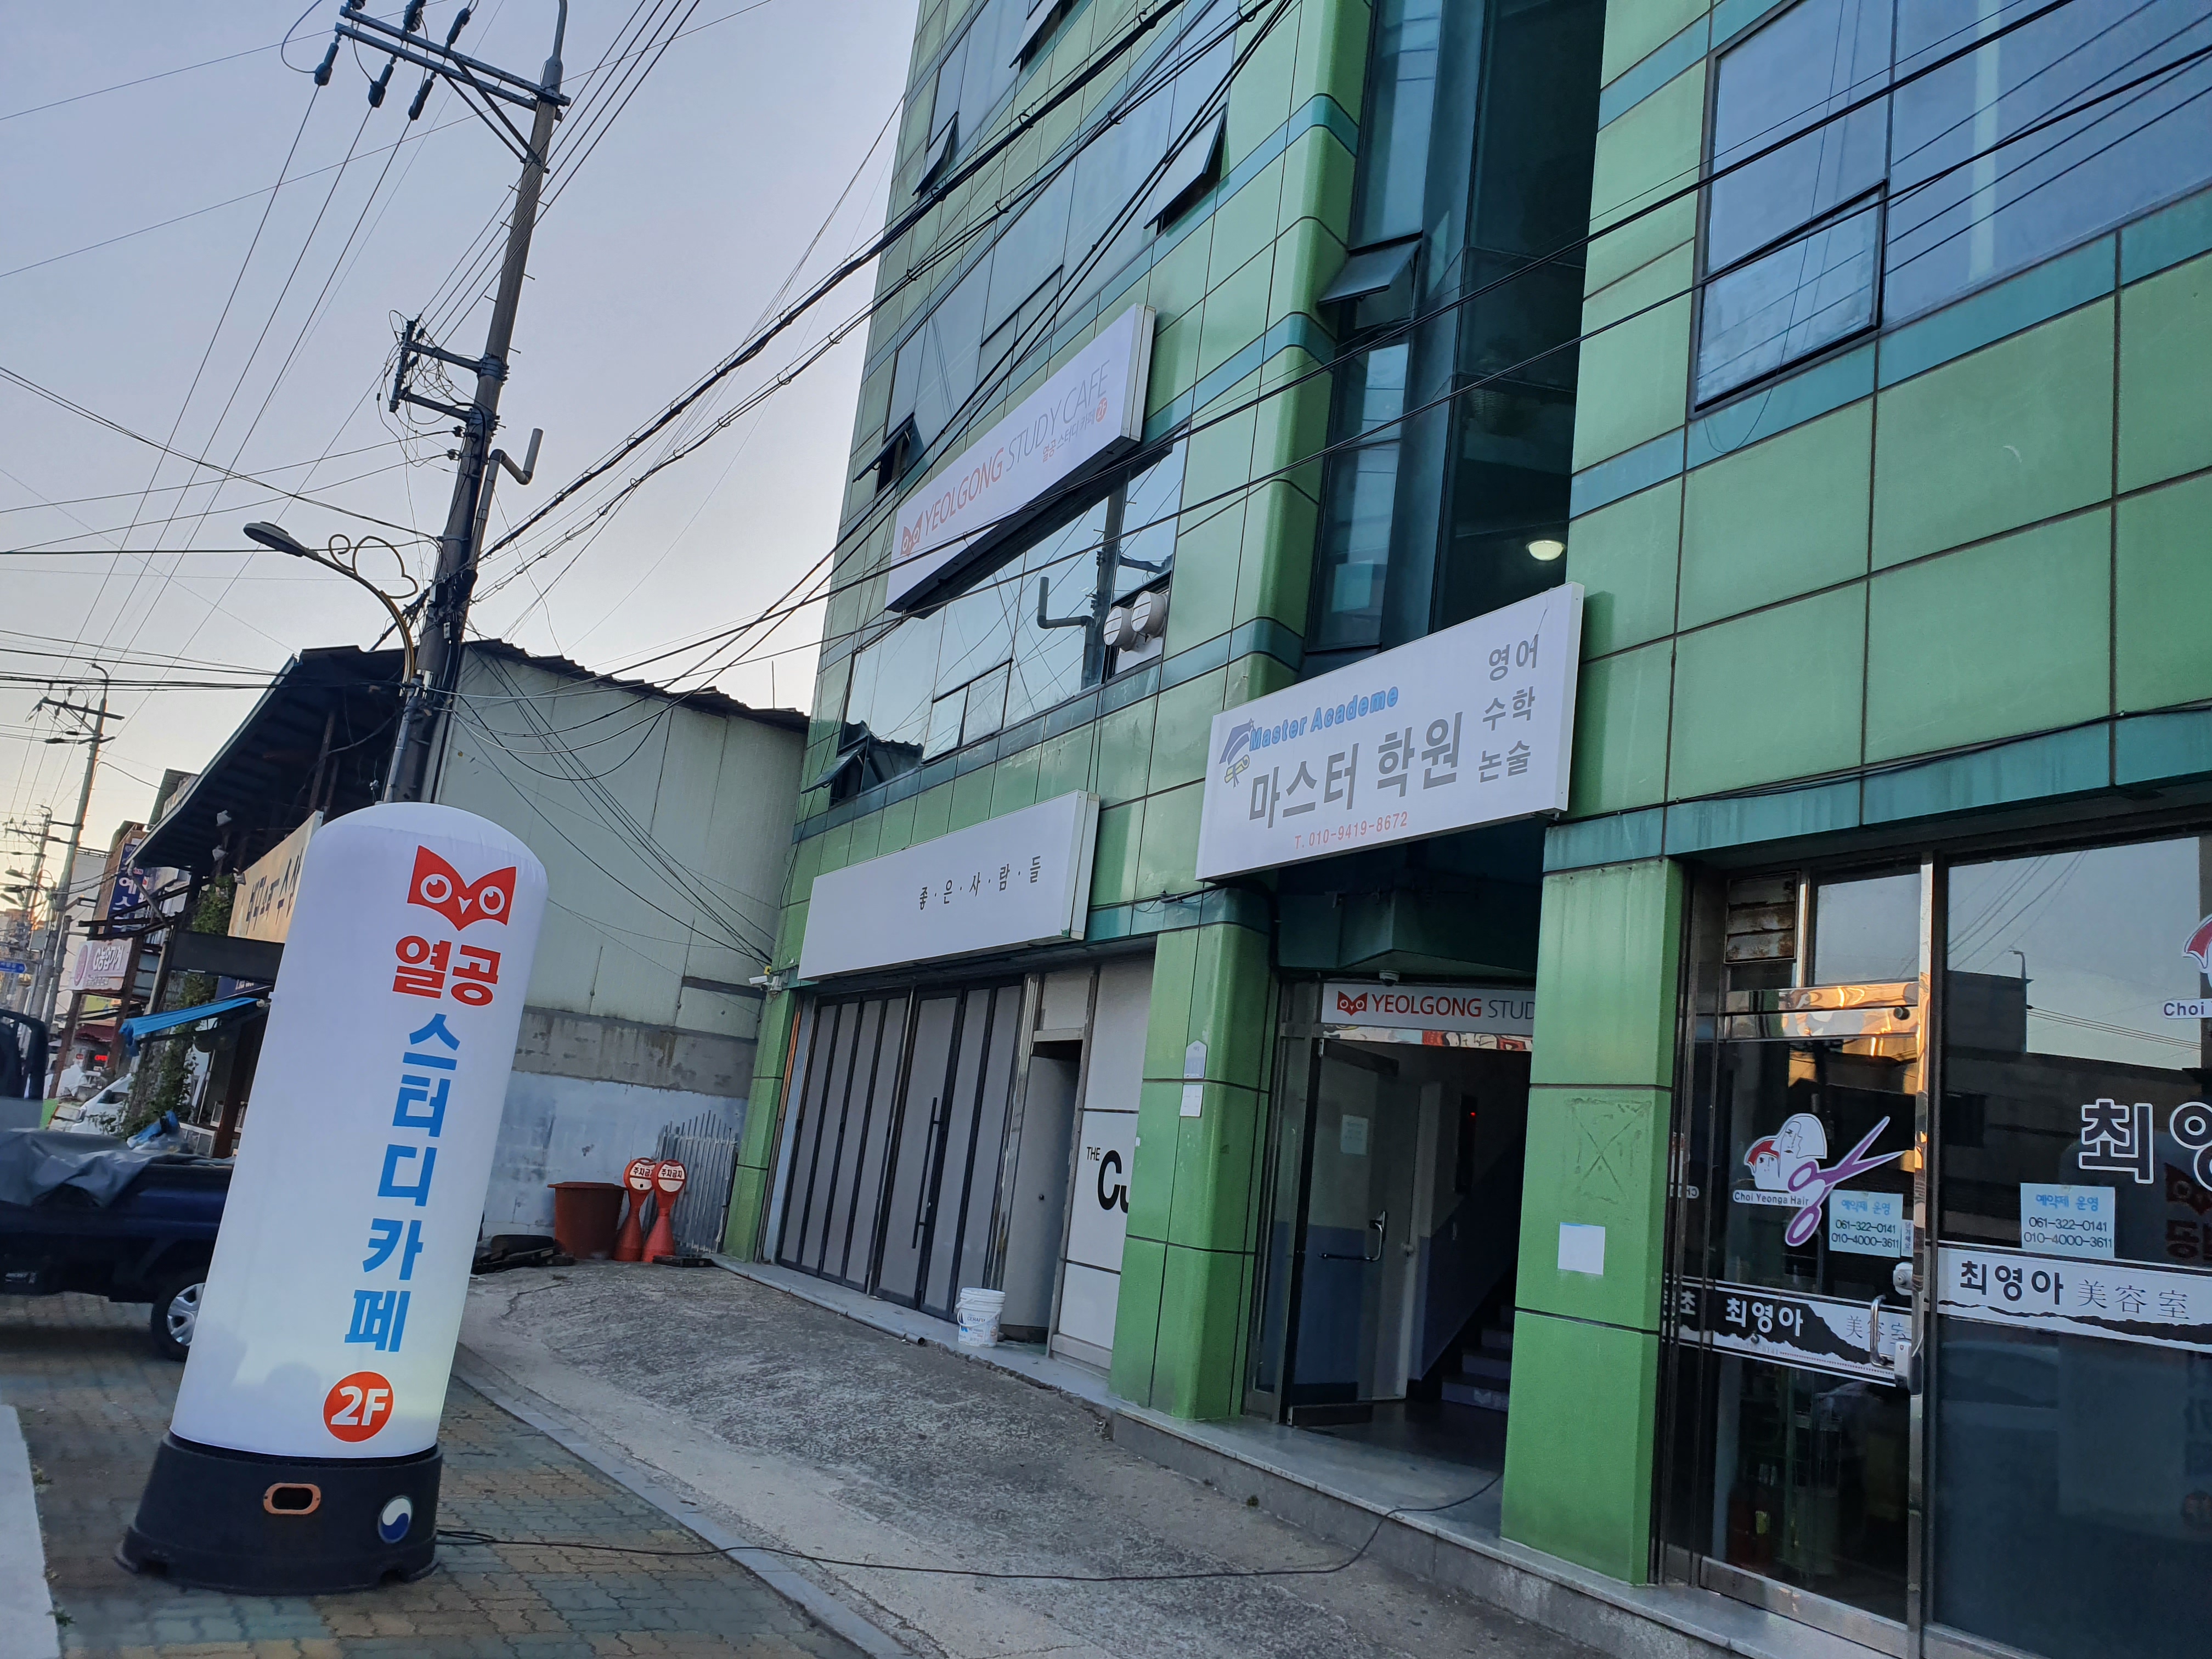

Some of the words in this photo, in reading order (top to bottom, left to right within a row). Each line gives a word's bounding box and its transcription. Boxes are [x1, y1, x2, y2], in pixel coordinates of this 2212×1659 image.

[1043, 439, 1056, 462] 열공
[1097, 400, 1107, 419] 2F
[925, 447, 1004, 536] YEOLGONG
[1006, 399, 1062, 472] STUDY
[1063, 359, 1109, 424] CAFE
[1488, 634, 1539, 681] 영어
[1249, 713, 1307, 752] Master
[1310, 685, 1399, 733] Academe
[1482, 686, 1536, 731] 수학
[1249, 743, 1359, 829] 마스터
[1377, 712, 1463, 797] 학원
[1479, 740, 1531, 783] 논술
[1309, 811, 1408, 848] 010-9419-8672
[392, 935, 501, 1006] 열공
[1372, 994, 1481, 1018] YEOLGONG
[1488, 1000, 1536, 1019] STUD
[2164, 1002, 2204, 1016] Choi
[1087, 1147, 1101, 1161] THE
[633, 1167, 653, 1177] 주차금
[661, 1169, 682, 1178] 주차금지
[1735, 1192, 1753, 1201] Choi
[1756, 1193, 1787, 1204] Yeonga
[1790, 1195, 1809, 1205] Hair
[1842, 1200, 1867, 1212] 예약제
[1872, 1201, 1891, 1215] 운영
[2036, 1194, 2069, 1209] 예약제
[2075, 1196, 2099, 1211] 운영
[1836, 1220, 1895, 1234] 061-322-0141
[2029, 1217, 2107, 1232] 061-322-0141
[1831, 1233, 1898, 1249] 010-4000-3611
[2024, 1232, 2112, 1249] 010-4000-3611
[1960, 1261, 2064, 1305] 최영아
[2078, 1279, 2190, 1320] 美容室
[1725, 1297, 1804, 1337] 최영아
[331, 1386, 389, 1426] 2F
